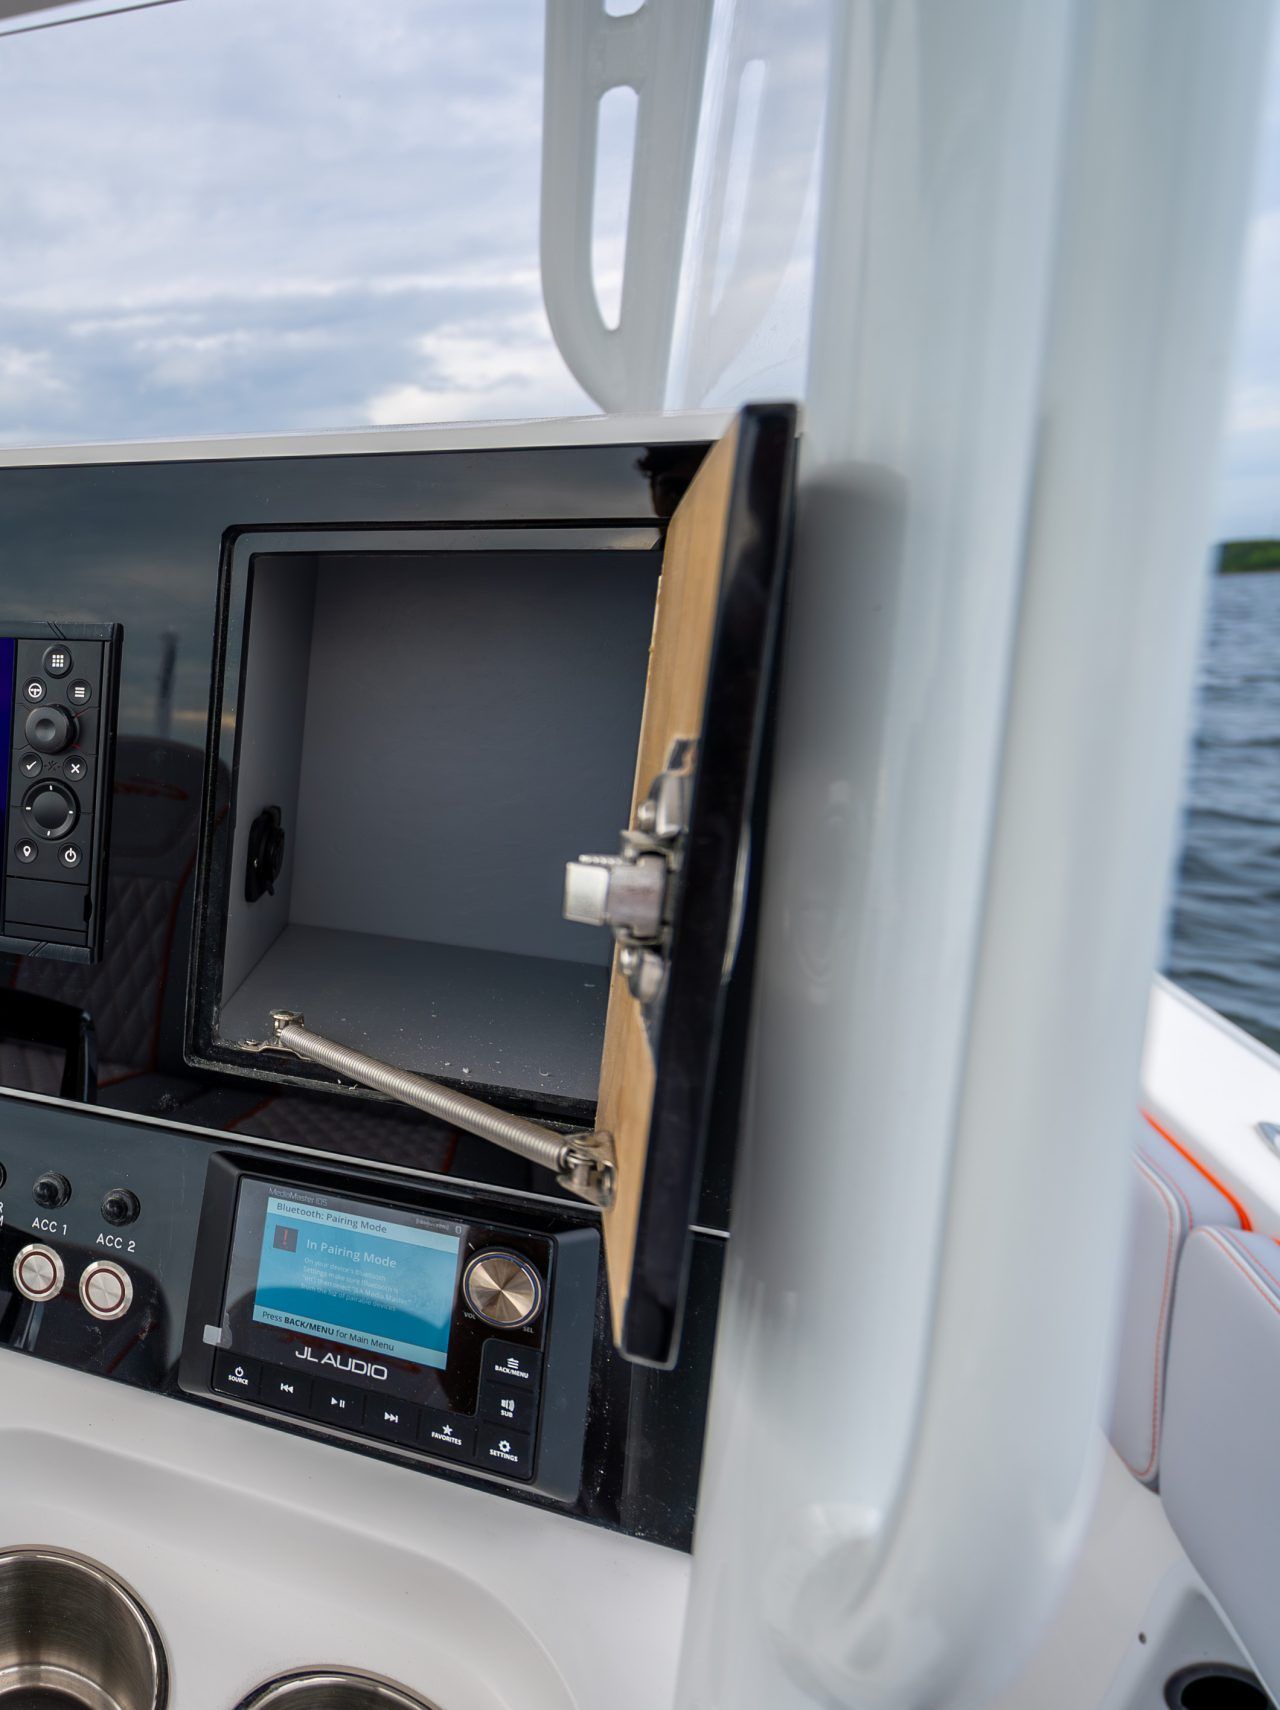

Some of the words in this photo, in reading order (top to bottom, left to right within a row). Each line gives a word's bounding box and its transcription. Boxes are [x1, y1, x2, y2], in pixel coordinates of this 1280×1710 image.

[276, 1202, 324, 1221] Bluetooth:
[326, 1213, 358, 1230] Pairing
[360, 1221, 388, 1234] Mode
[31, 1217, 57, 1233] ACC
[62, 1224, 68, 1236] 1
[96, 1233, 123, 1249] ACC
[127, 1241, 136, 1253] 2
[306, 1239, 317, 1251] In
[320, 1243, 361, 1262] Pairing
[364, 1251, 398, 1269] Mode
[463, 1311, 477, 1320] VOL
[262, 1311, 283, 1323] Press
[284, 1316, 335, 1336] BACK/MENU
[335, 1329, 348, 1339] for
[349, 1332, 369, 1345] Main
[370, 1339, 395, 1351] Menu
[522, 1326, 535, 1334] SEL
[295, 1346, 319, 1363] JL
[320, 1352, 388, 1381] AUDIO
[494, 1364, 529, 1379] BACK/MENU
[227, 1374, 249, 1386] SOURCE
[500, 1409, 514, 1419] SUB
[431, 1431, 462, 1446] FAVORITES
[489, 1448, 518, 1463] SETTINGS
